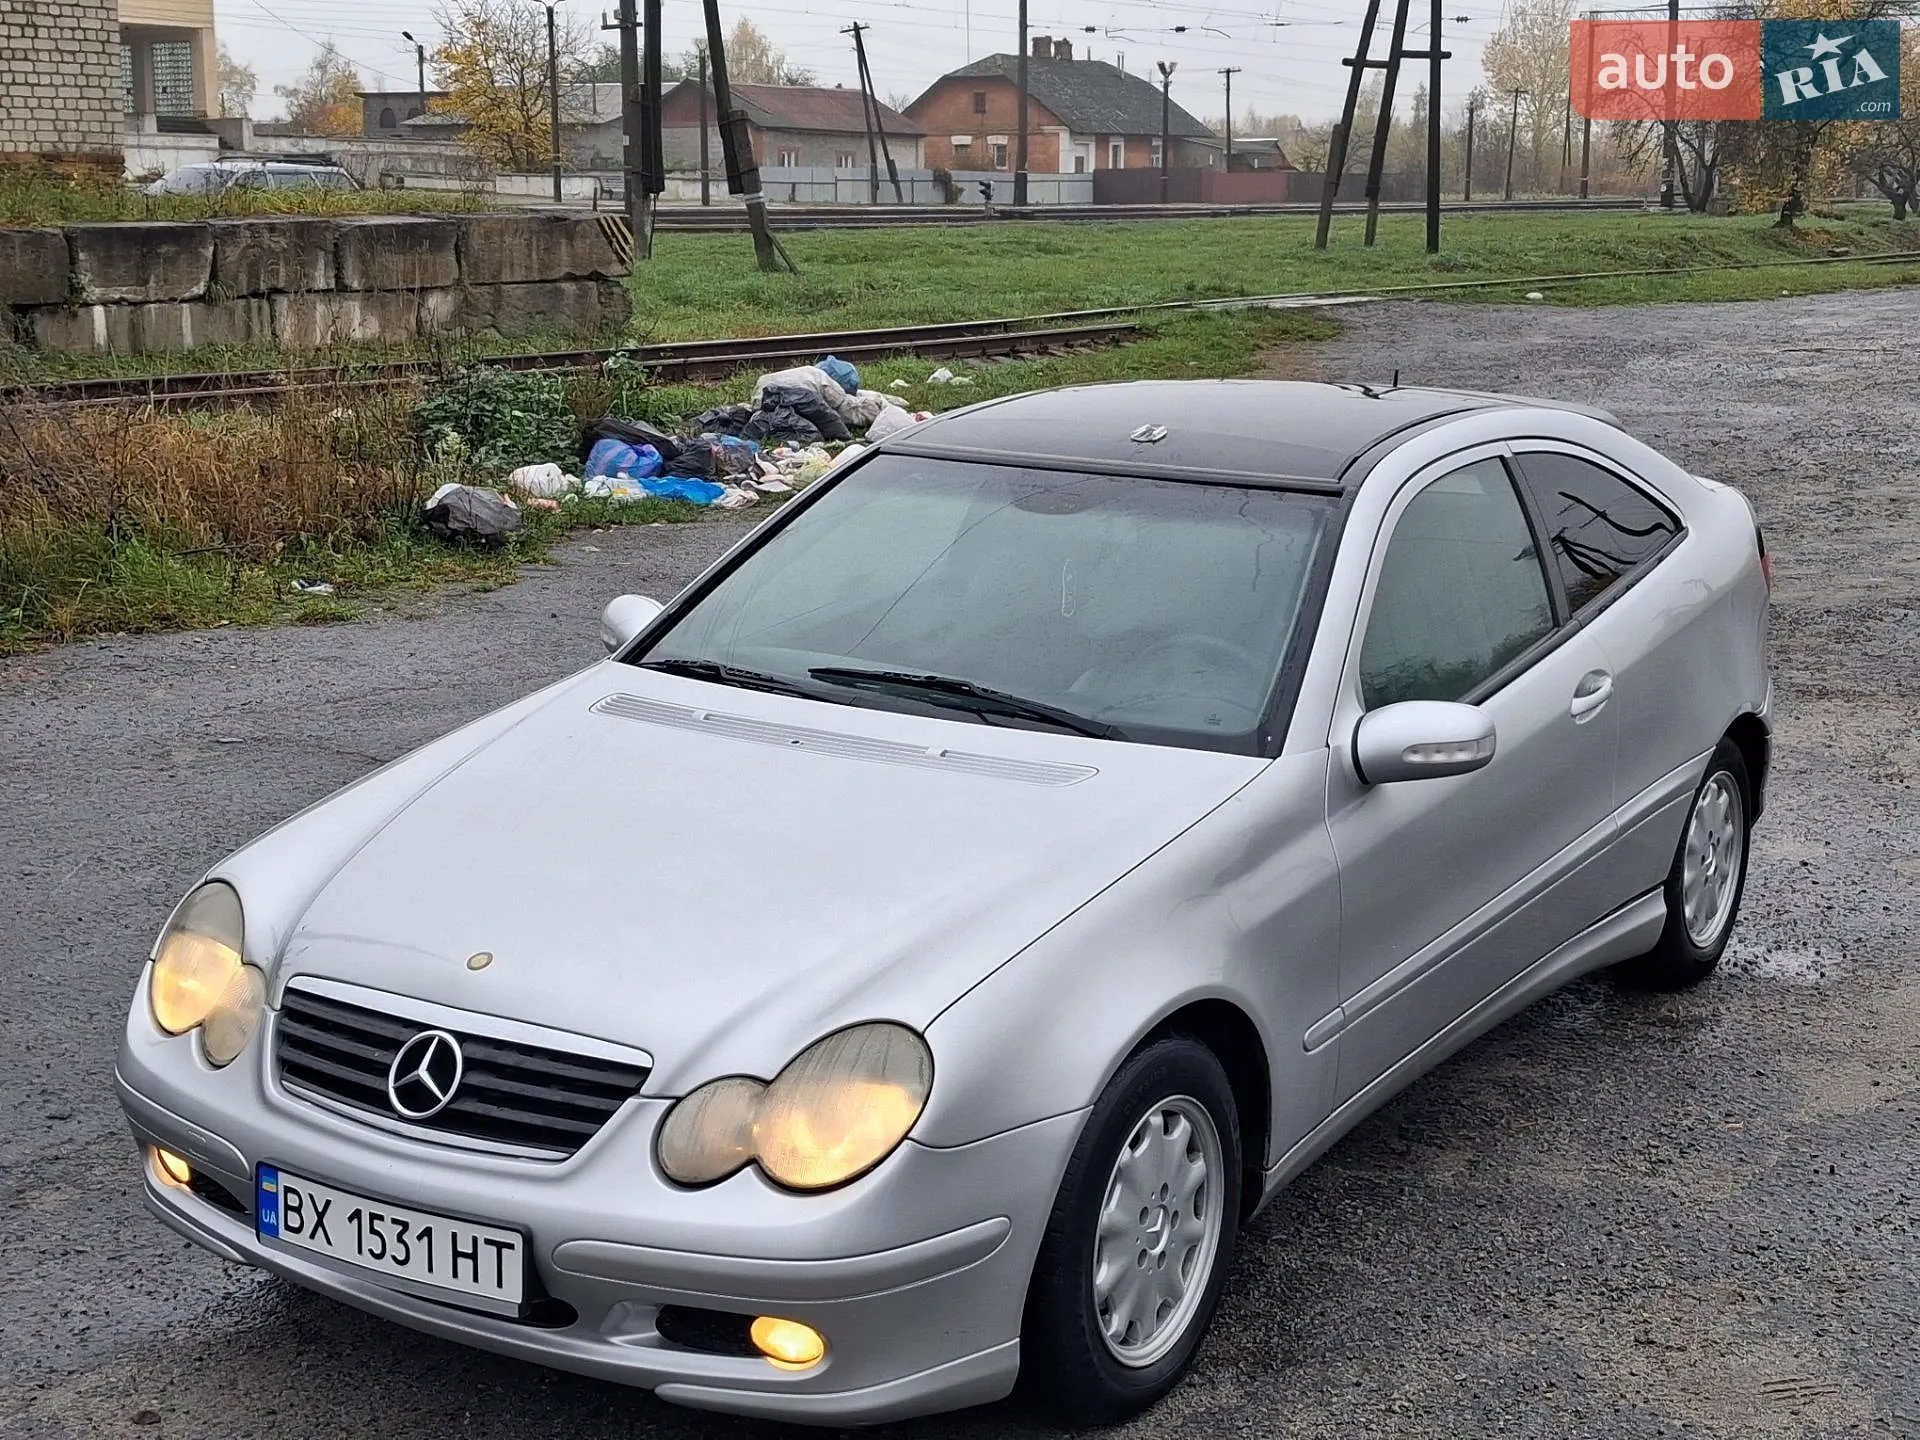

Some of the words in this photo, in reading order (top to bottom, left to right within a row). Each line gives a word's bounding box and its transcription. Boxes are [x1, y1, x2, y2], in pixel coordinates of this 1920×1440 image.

[262, 1208, 278, 1226] UA
[283, 1184, 334, 1247] BX
[347, 1207, 434, 1274] 1531
[451, 1231, 516, 1289] HT
